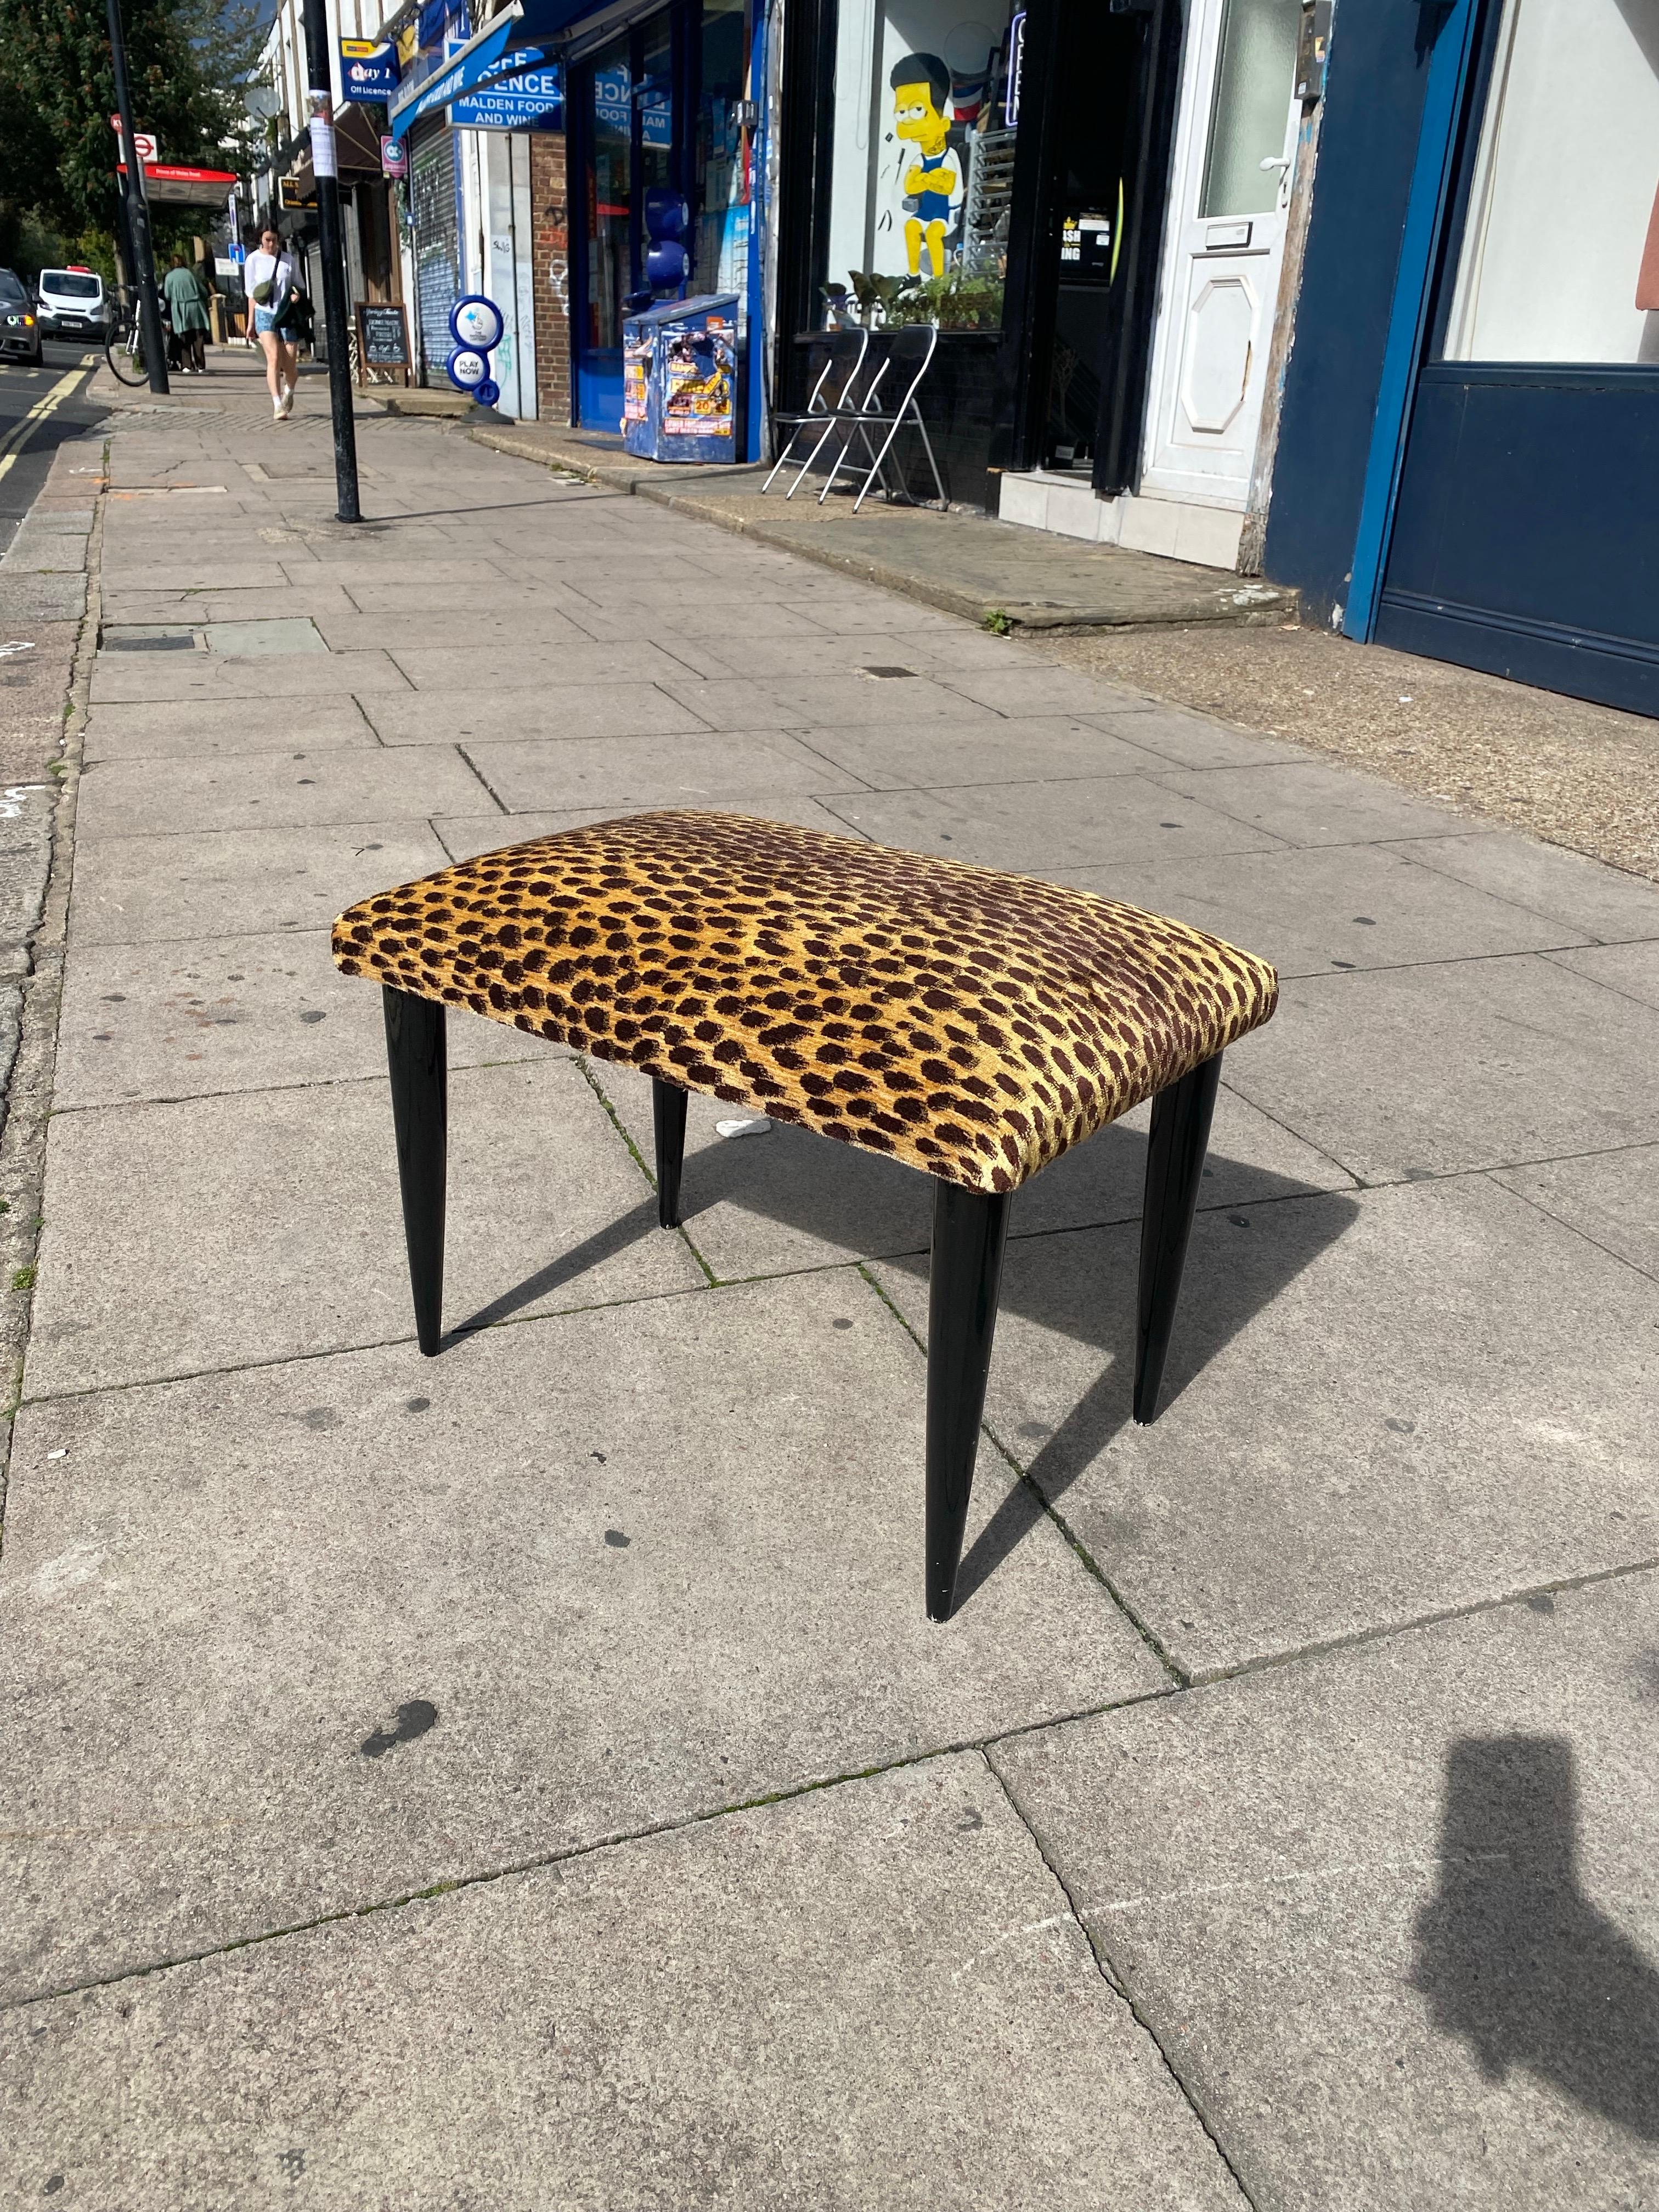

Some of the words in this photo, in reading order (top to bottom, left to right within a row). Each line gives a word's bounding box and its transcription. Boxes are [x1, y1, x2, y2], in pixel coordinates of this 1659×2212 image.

[385, 67, 391, 78] 1
[363, 86, 391, 95] Licence
[459, 97, 514, 110] MALDEN
[517, 101, 554, 114] FOOD
[475, 112, 503, 124] AND
[506, 114, 539, 127] WINE
[1060, 247, 1080, 260] ING
[696, 402, 709, 410] 20
